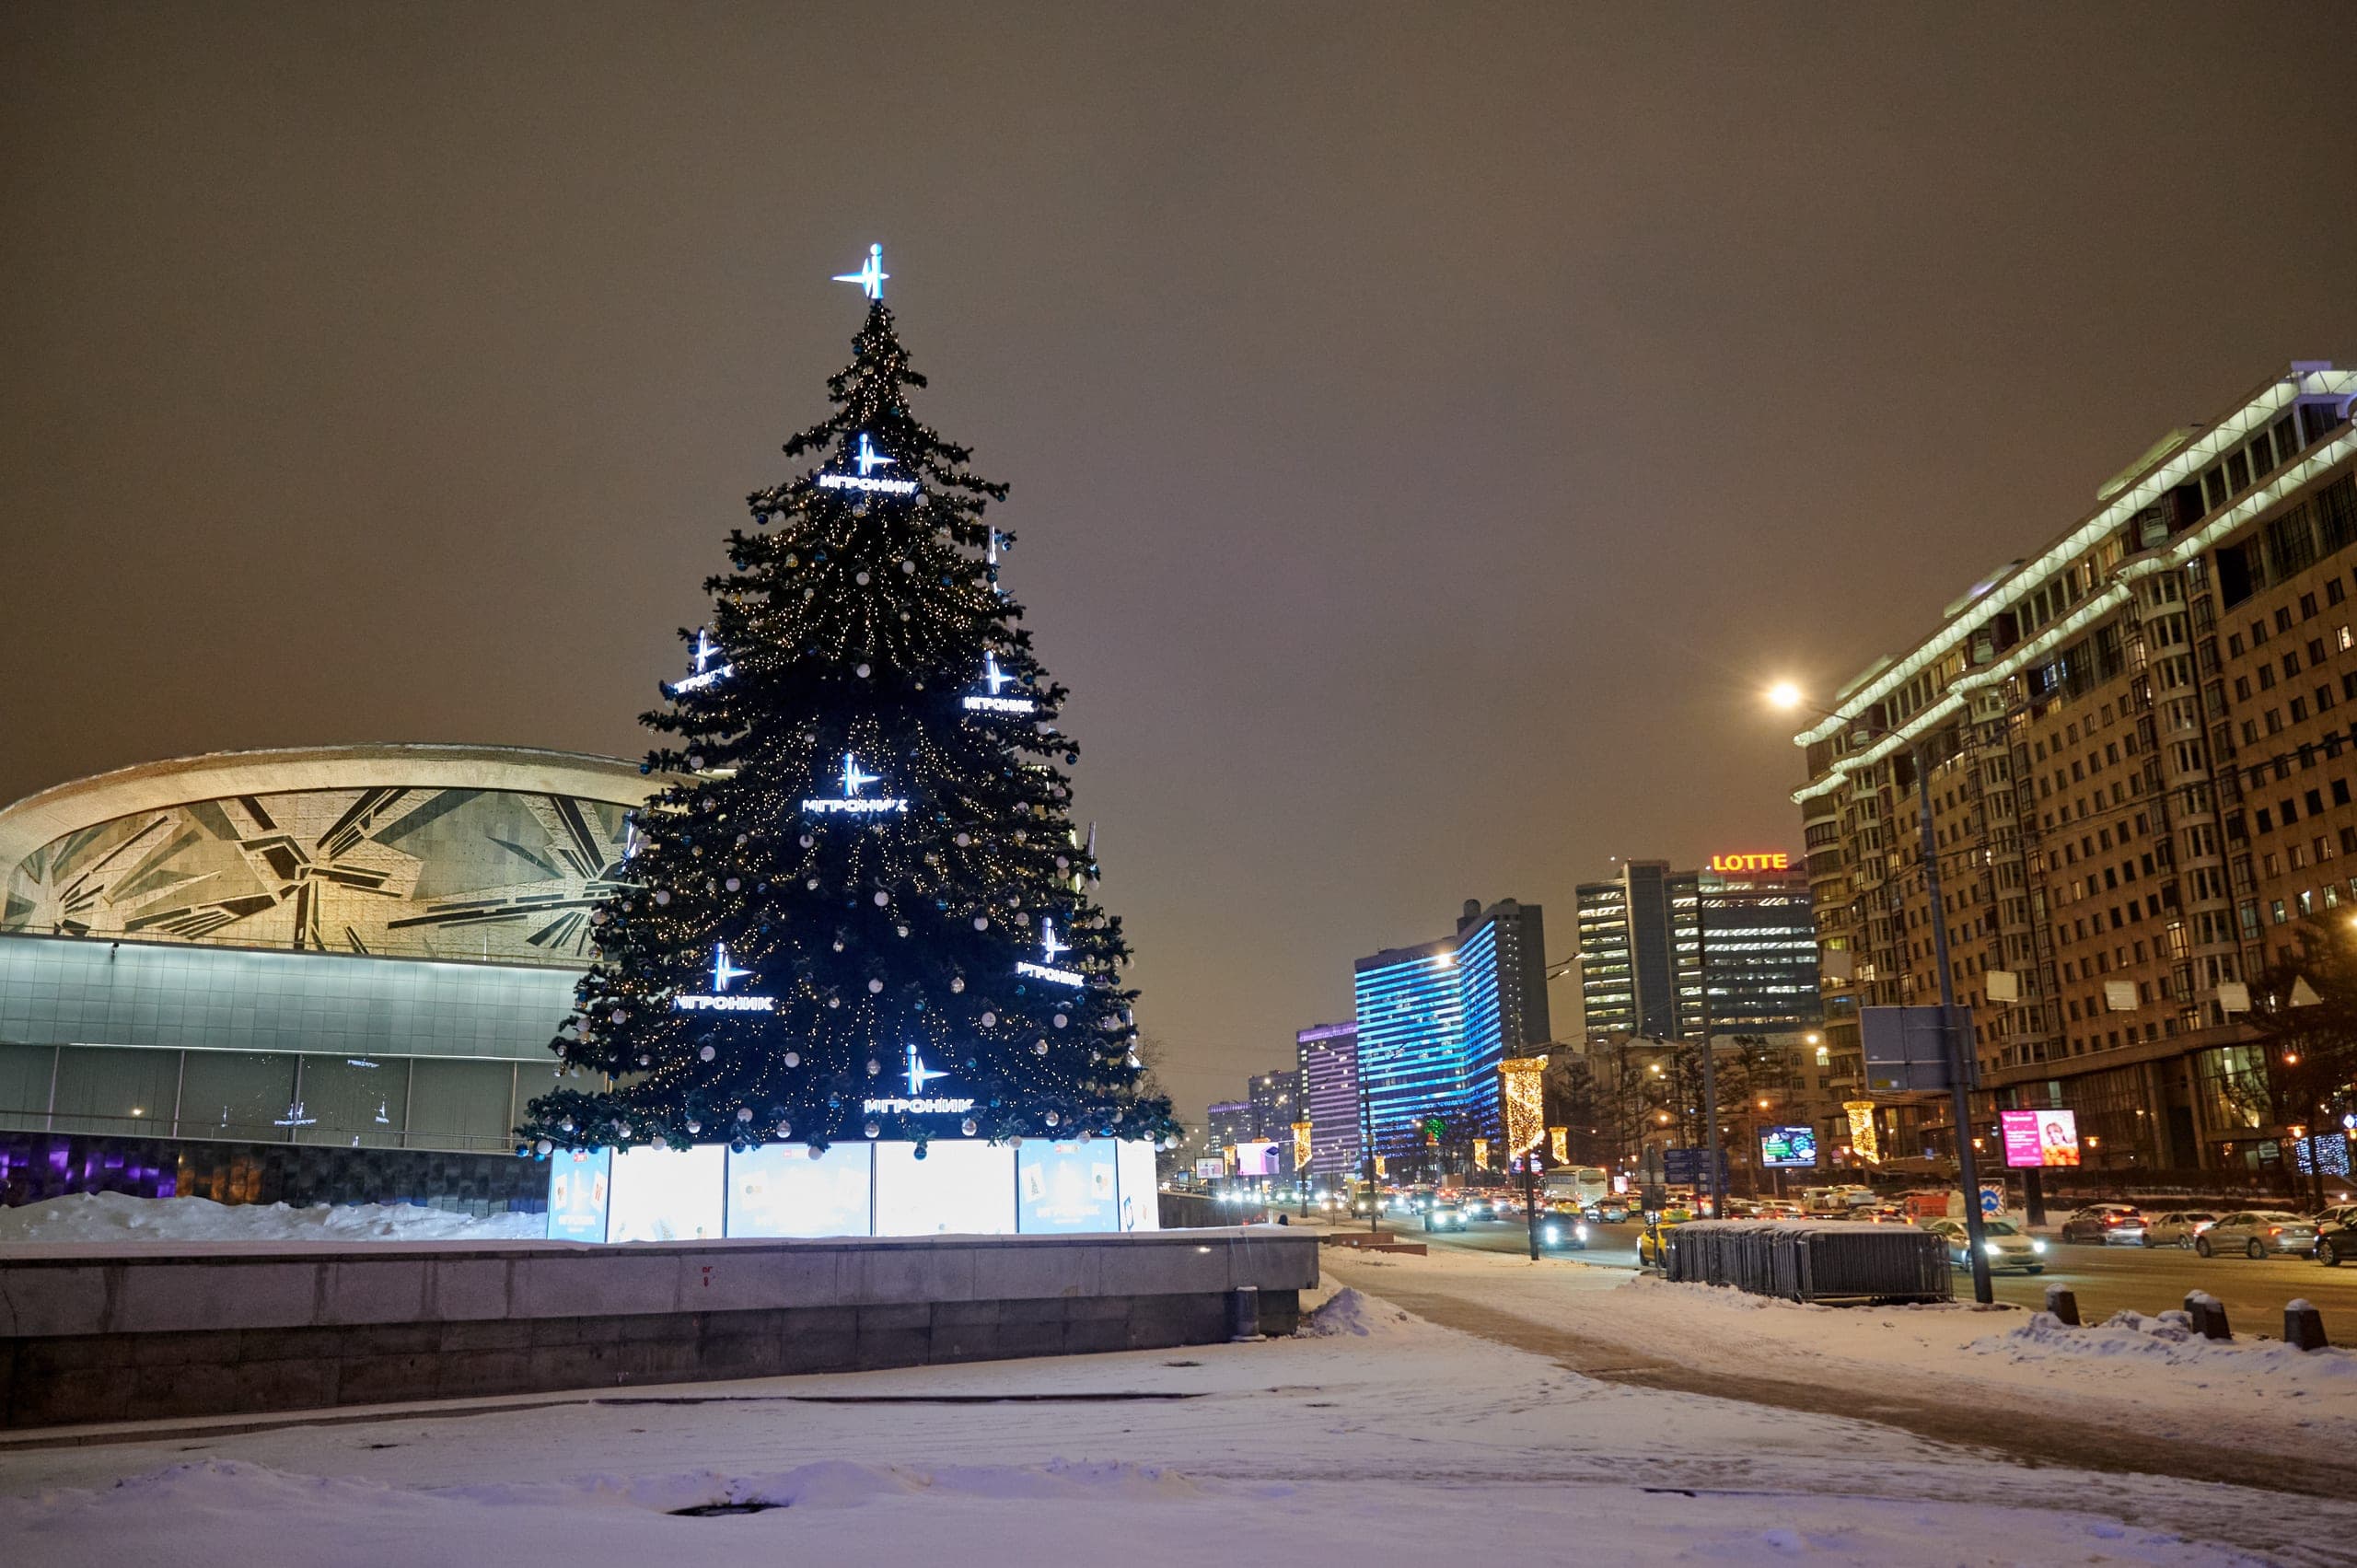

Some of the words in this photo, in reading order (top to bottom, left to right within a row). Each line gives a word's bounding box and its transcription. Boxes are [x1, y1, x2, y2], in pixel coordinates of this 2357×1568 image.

[819, 474, 917, 494] ИГРОНИК
[963, 696, 1034, 713] ИГРОНИК
[802, 799, 909, 812] ИГРОНИК
[1713, 854, 1788, 870] LOTTE
[1016, 961, 1085, 987] ИГРОНИК
[674, 995, 774, 1010] ИГРОНИК
[864, 1098, 974, 1113] ИГРОНИК
